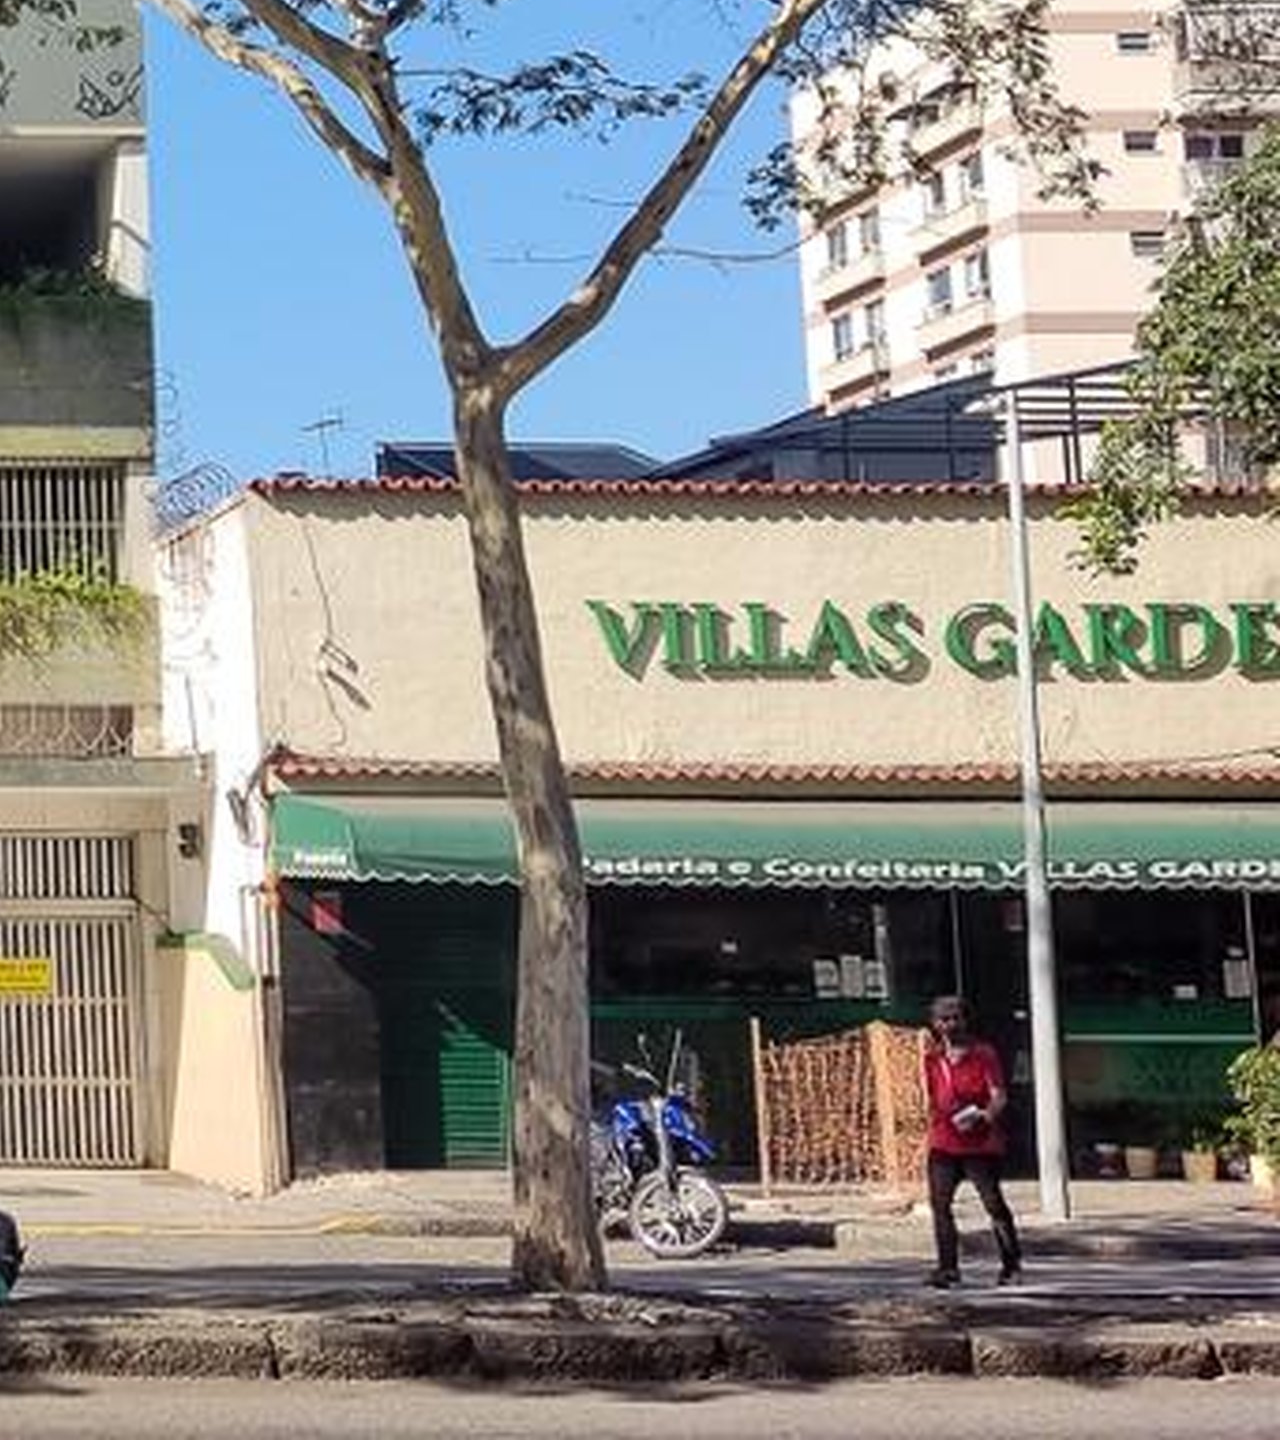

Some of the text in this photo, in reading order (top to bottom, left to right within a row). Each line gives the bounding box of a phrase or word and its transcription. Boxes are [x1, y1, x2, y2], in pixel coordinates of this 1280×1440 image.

[584, 600, 1280, 682] VILLAS GARDE
[763, 858, 985, 879] Confeitaria
[997, 860, 1139, 879] VLLAS
